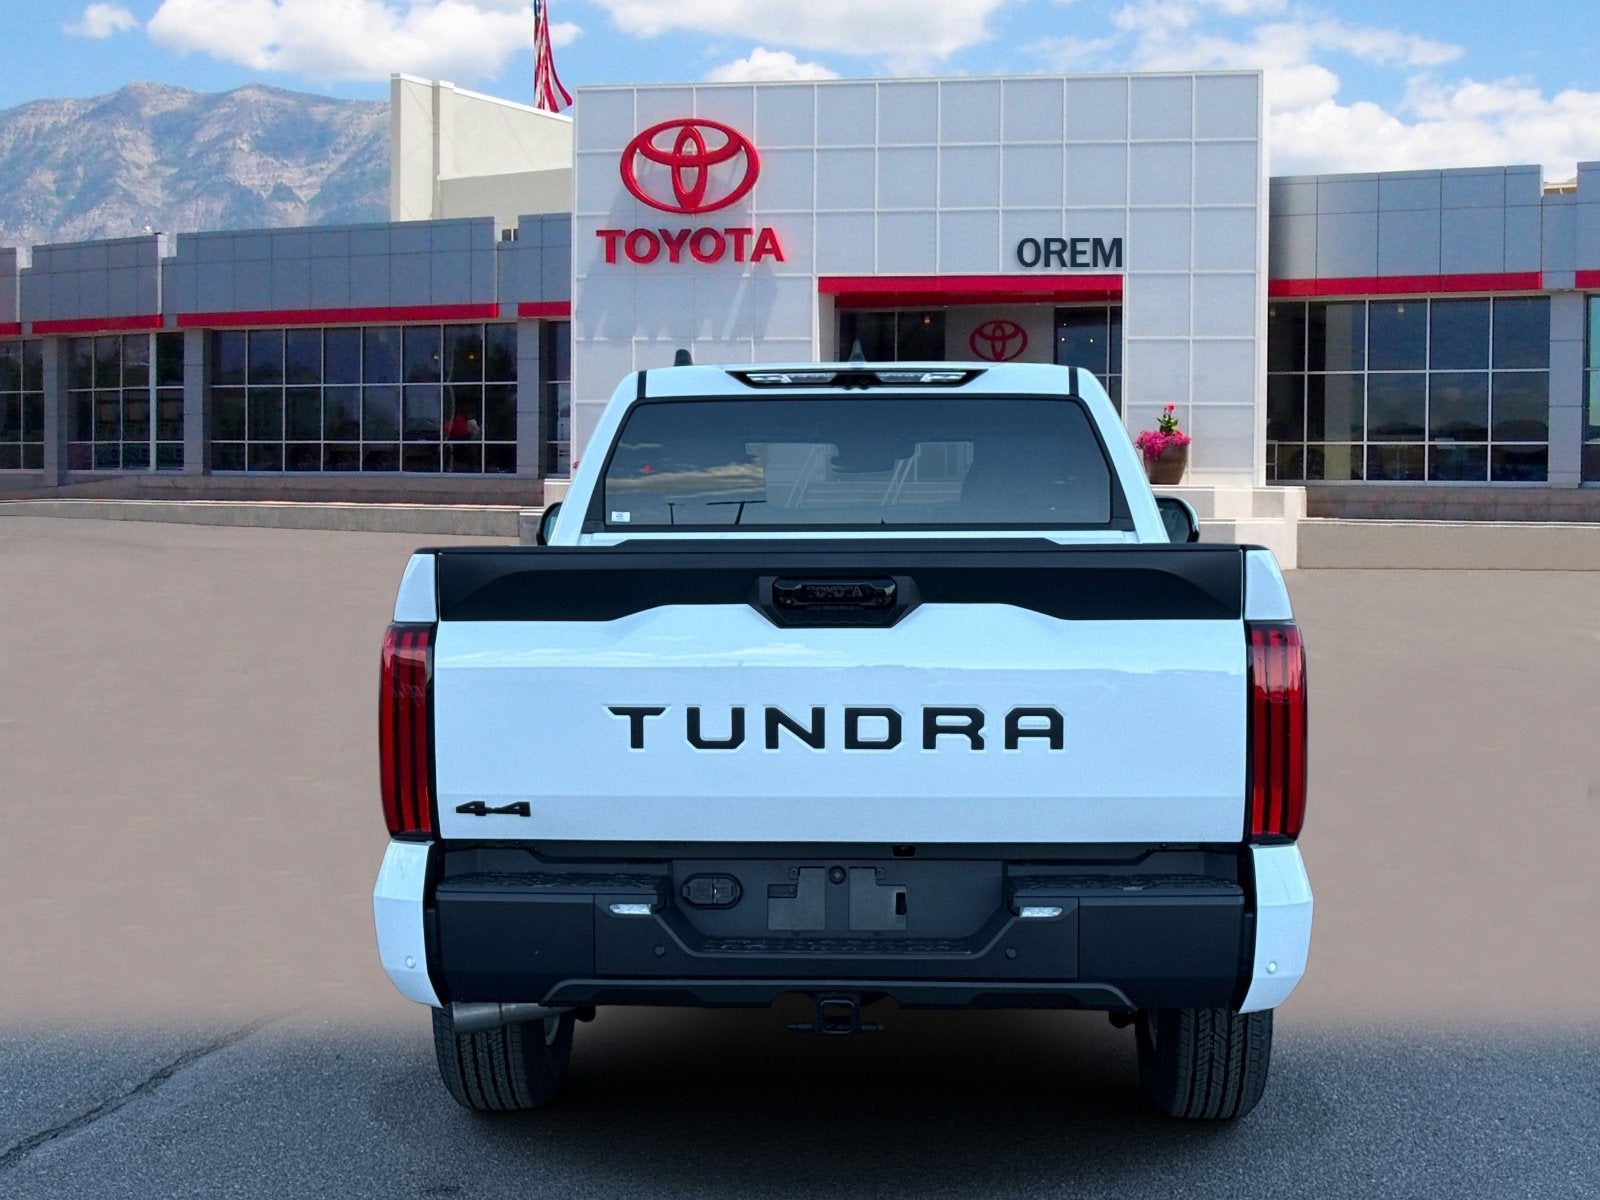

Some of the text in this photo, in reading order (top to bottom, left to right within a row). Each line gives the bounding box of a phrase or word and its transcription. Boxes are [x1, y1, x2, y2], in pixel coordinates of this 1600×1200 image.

[597, 228, 785, 264] TOYOTA
[1017, 238, 1123, 268] OREM
[608, 707, 1064, 751] TUNDRA
